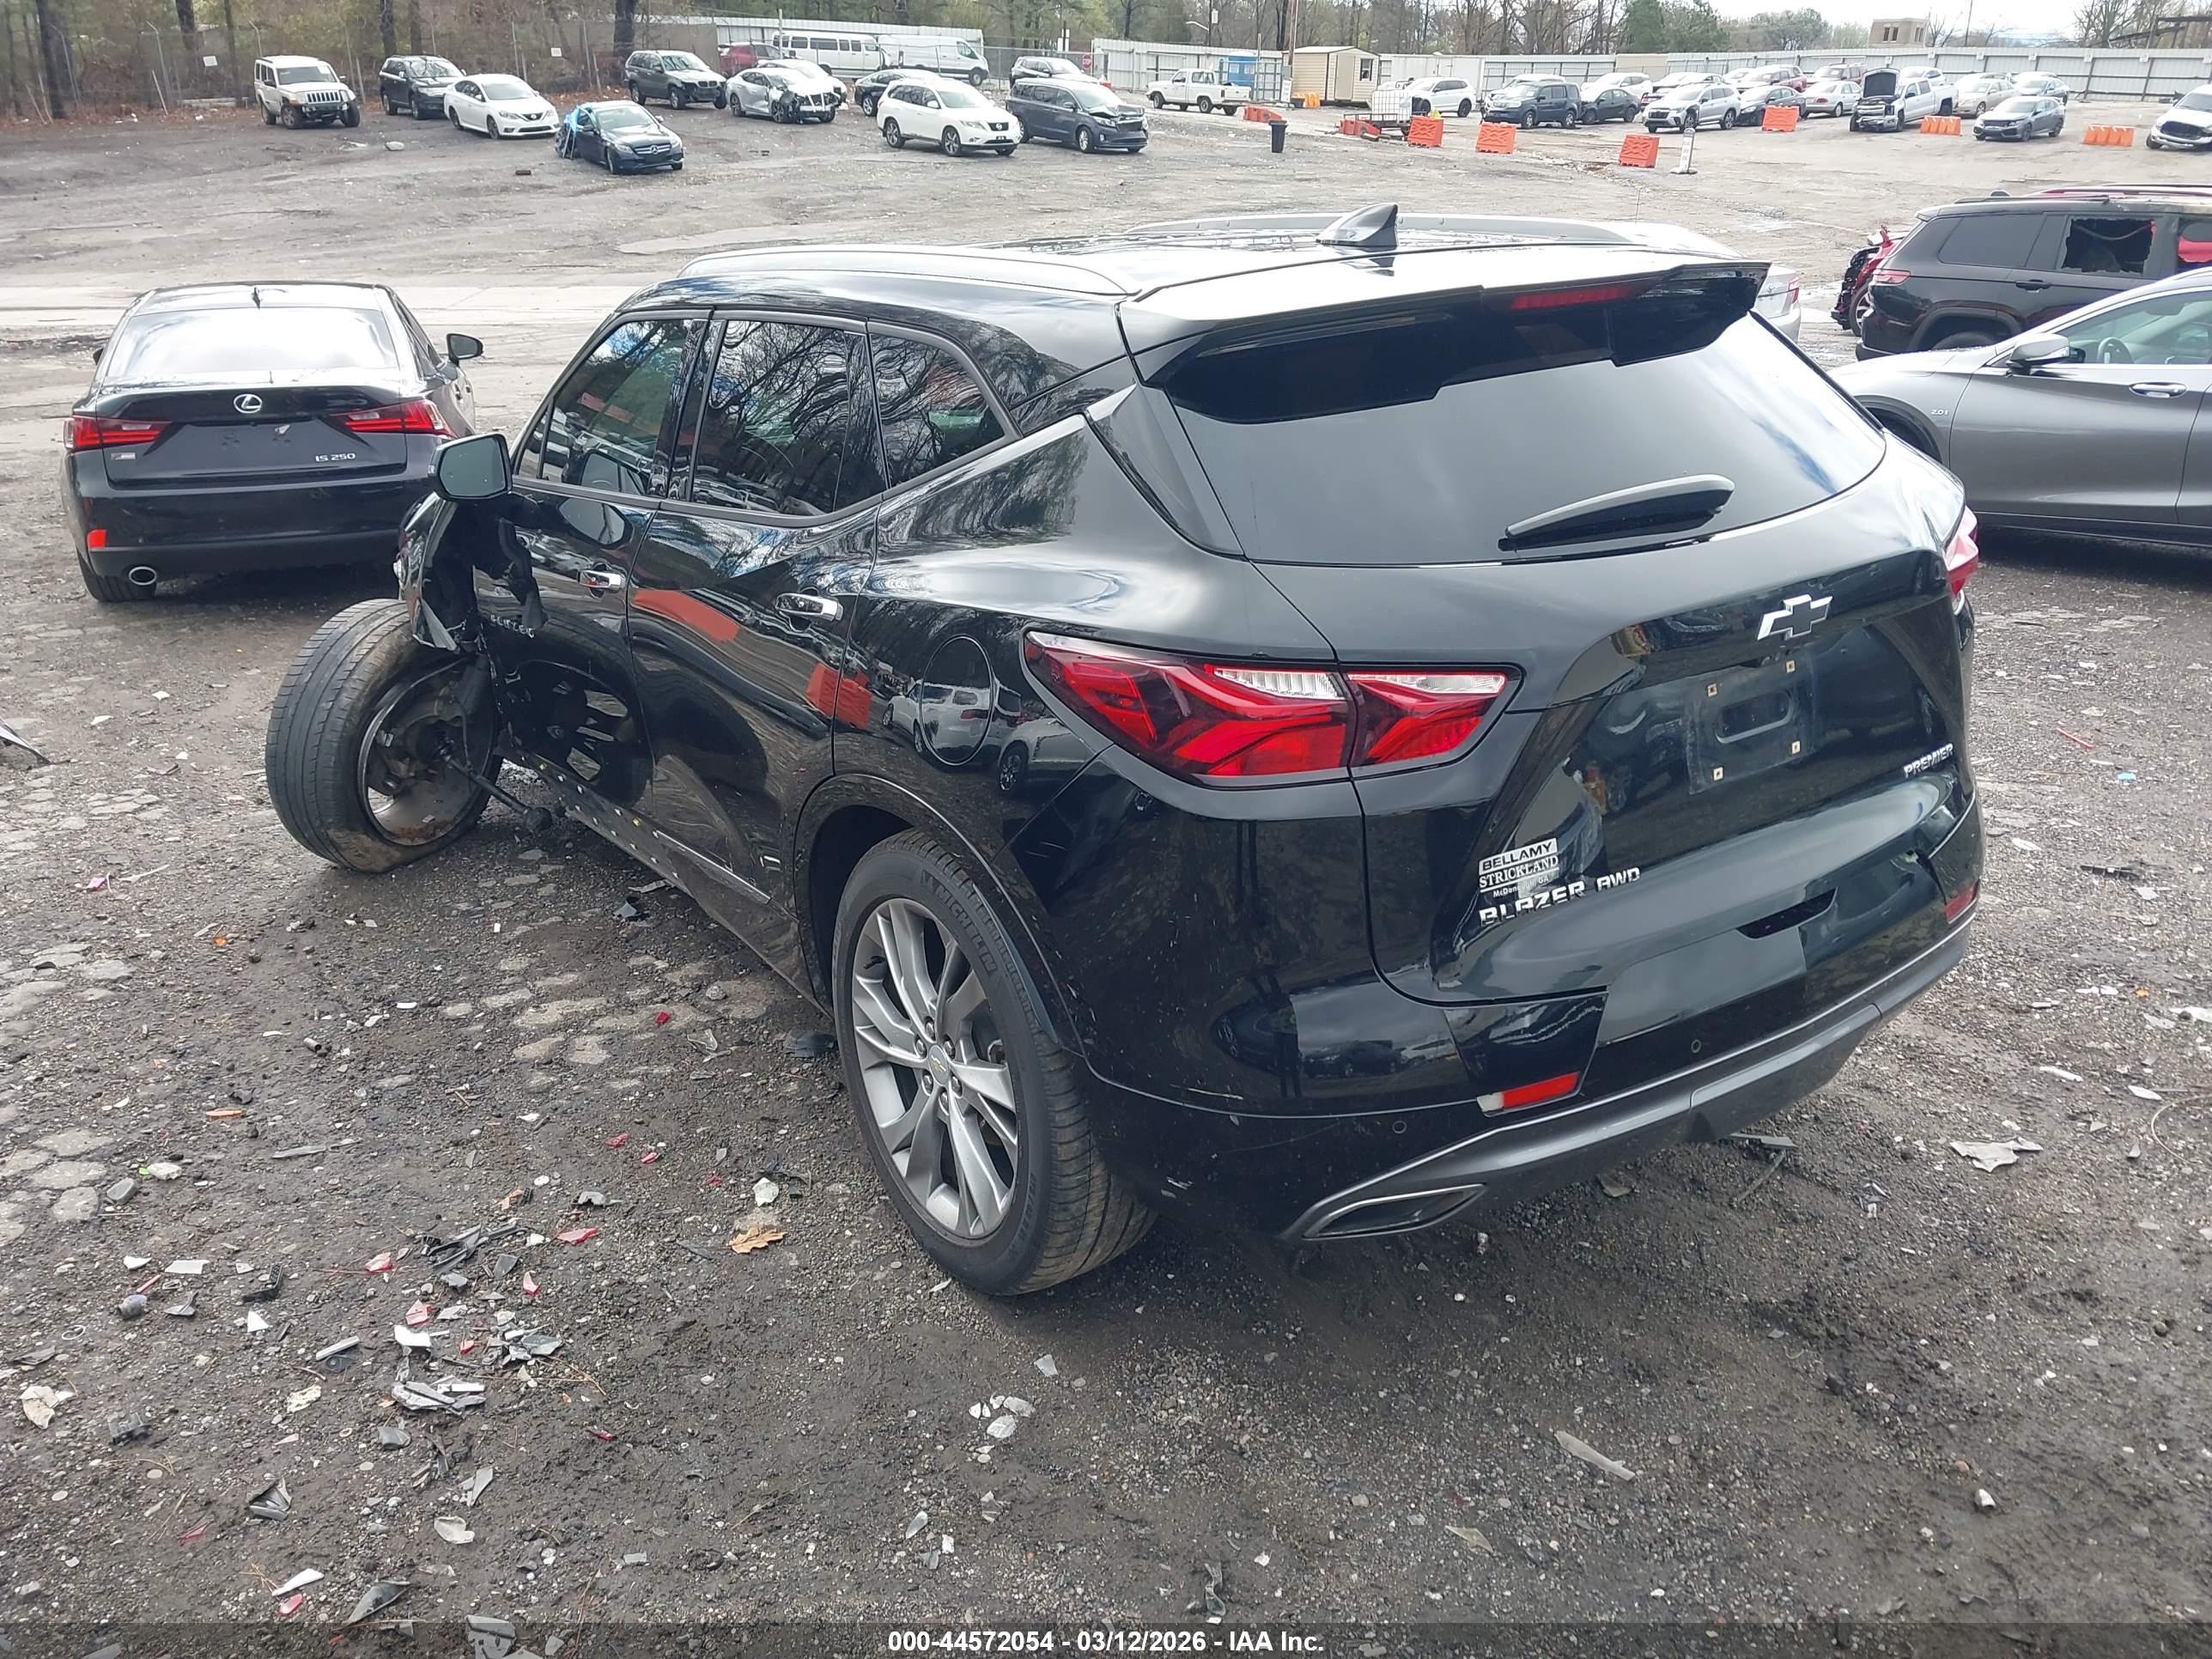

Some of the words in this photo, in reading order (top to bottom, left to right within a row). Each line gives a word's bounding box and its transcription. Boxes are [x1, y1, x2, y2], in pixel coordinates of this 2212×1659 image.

[331, 453, 356, 461] 250
[1904, 744, 1954, 779] PREMIER
[1479, 855, 1559, 888] STRICKLAND
[1482, 842, 1553, 872] BELLAMY
[1538, 874, 1550, 884] GA
[1479, 881, 1586, 927] BLAZER
[1595, 867, 1640, 891] AWD
